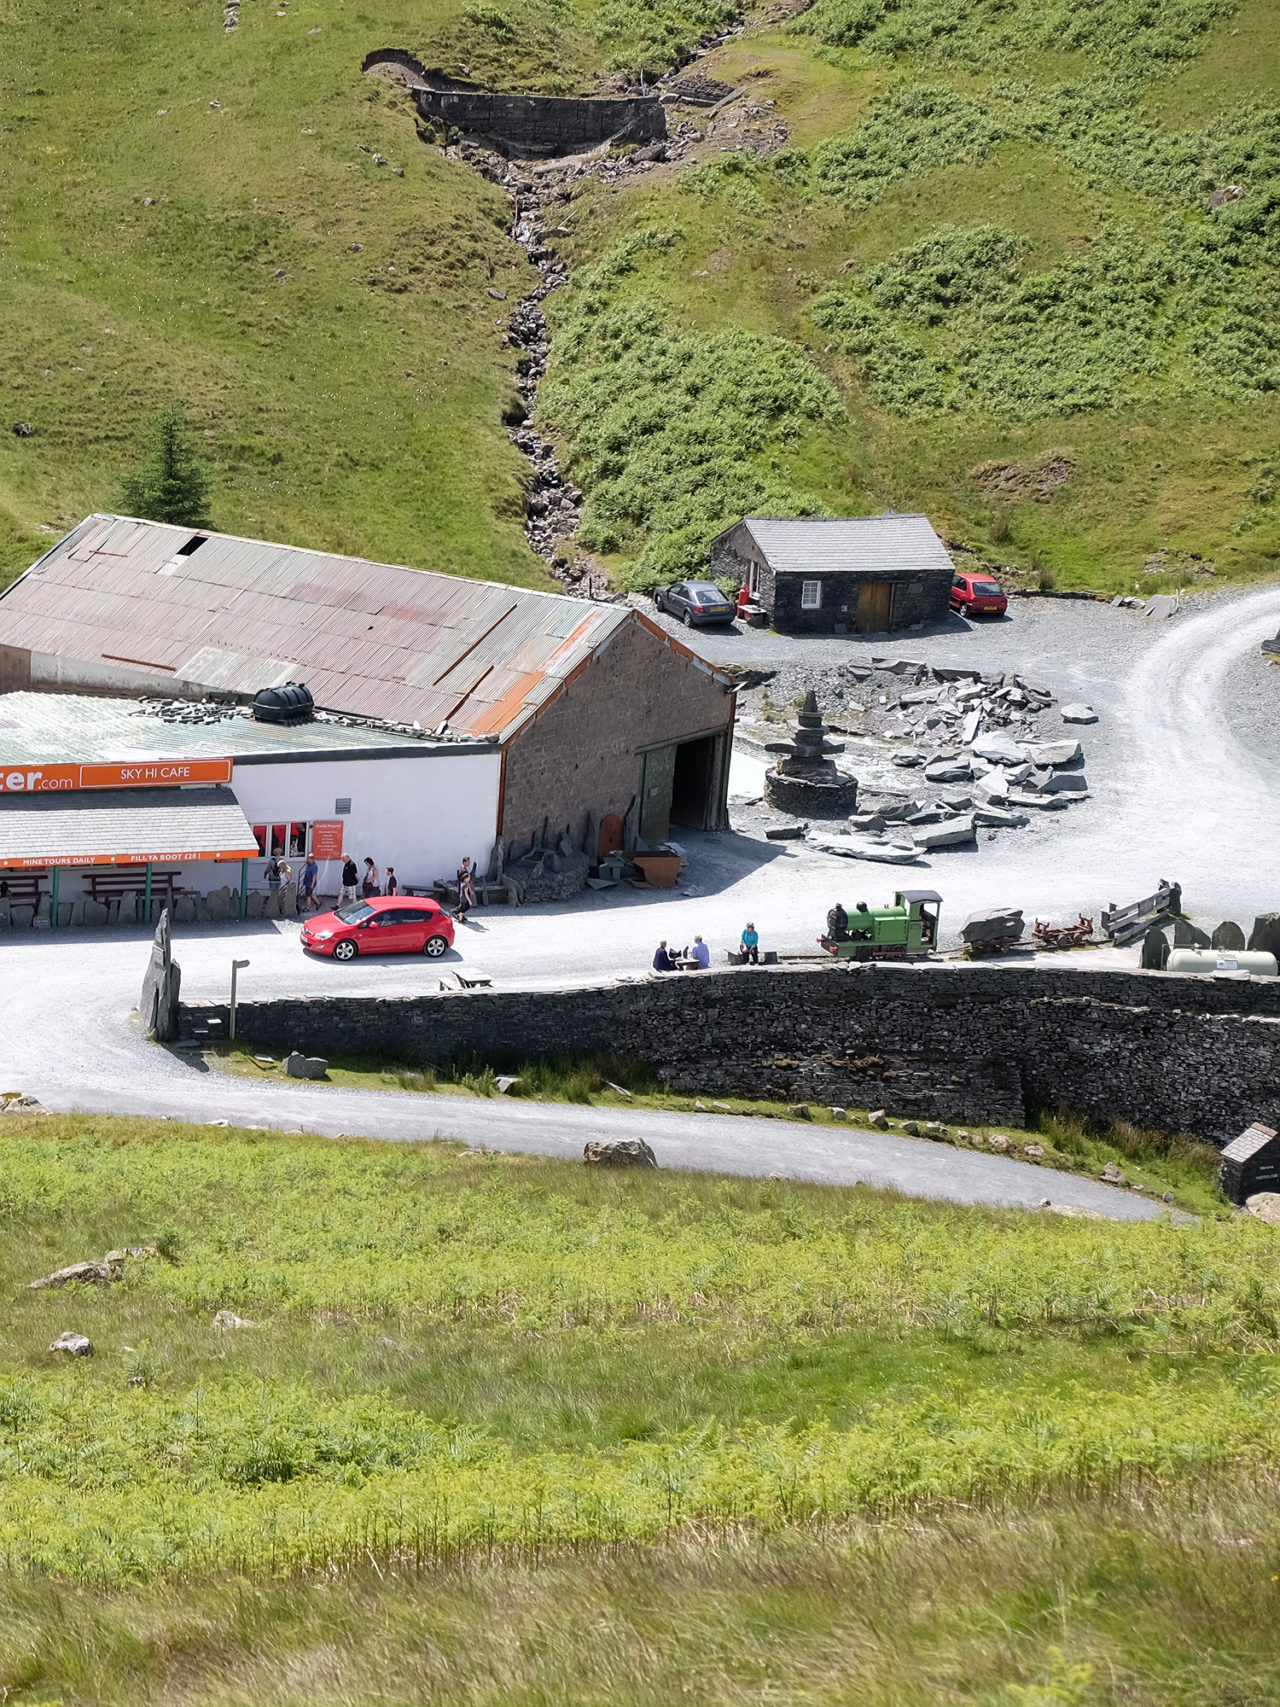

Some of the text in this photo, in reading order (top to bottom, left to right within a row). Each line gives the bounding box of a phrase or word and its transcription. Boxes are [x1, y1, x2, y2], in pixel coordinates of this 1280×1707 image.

[120, 766, 190, 780] SKY HI CAFE
[23, 856, 96, 866] MINE TOURS DAILY
[131, 854, 147, 862] FILL
[160, 853, 182, 861] BOOT
